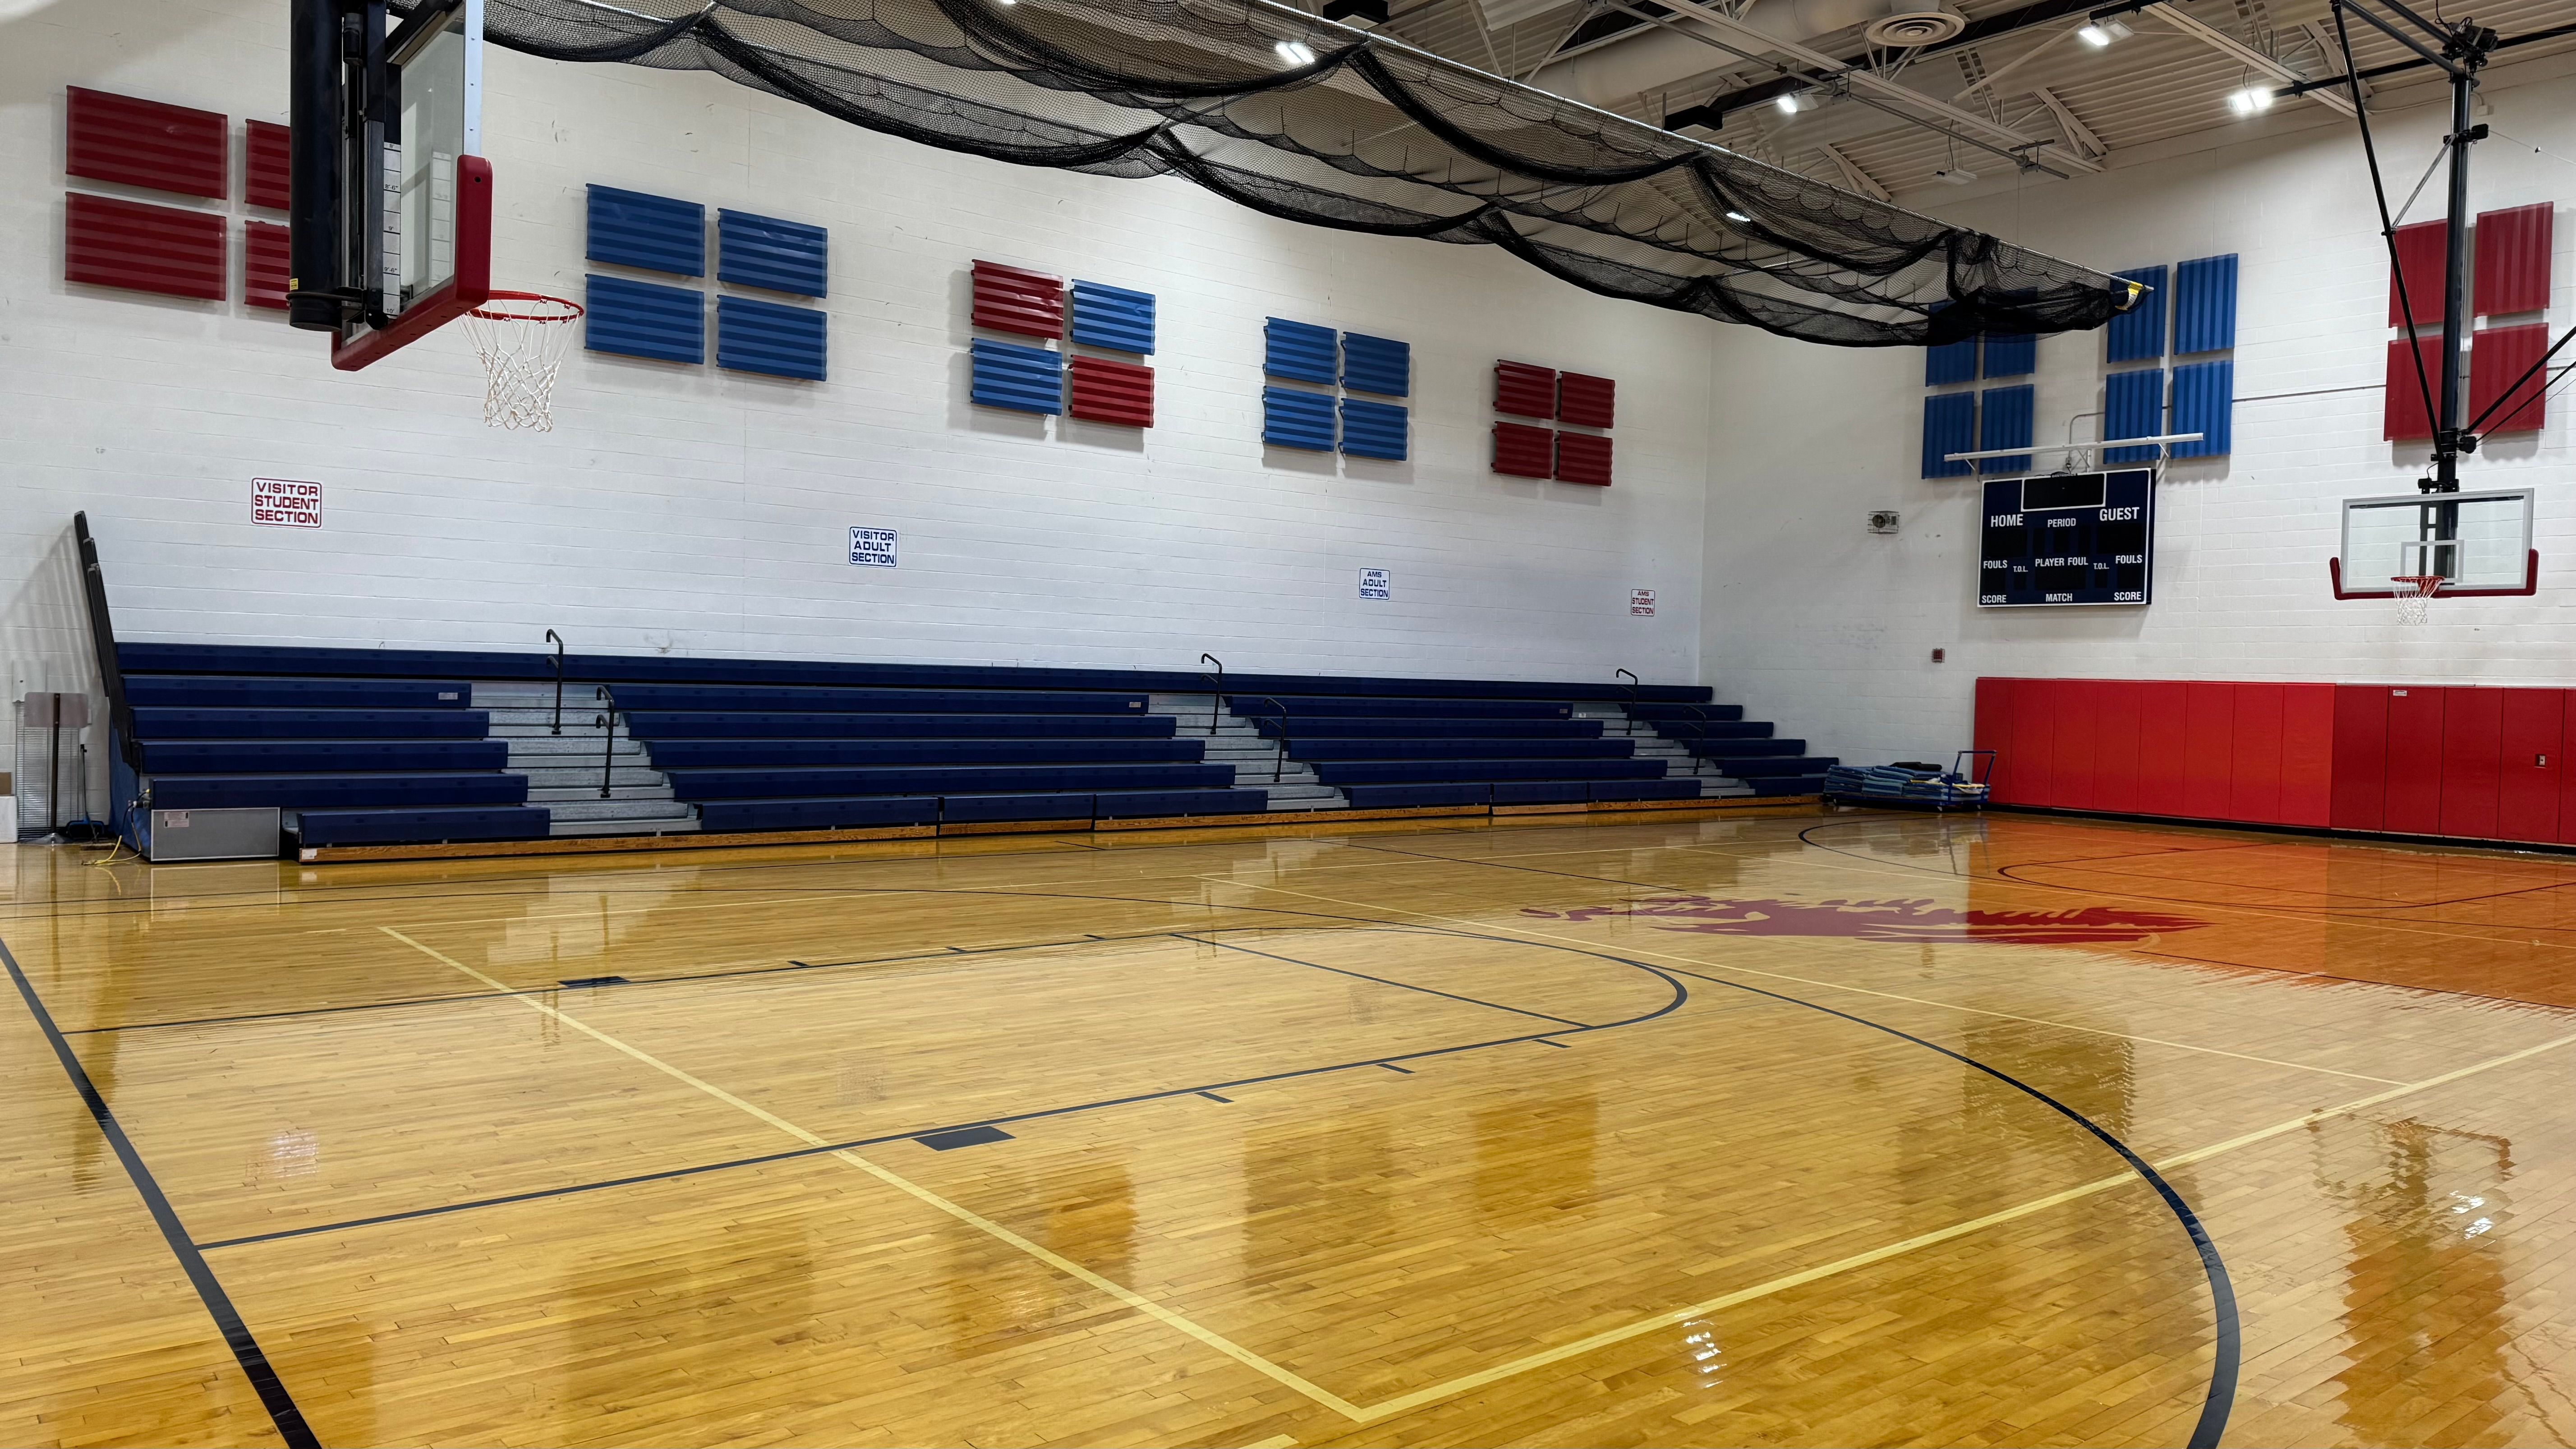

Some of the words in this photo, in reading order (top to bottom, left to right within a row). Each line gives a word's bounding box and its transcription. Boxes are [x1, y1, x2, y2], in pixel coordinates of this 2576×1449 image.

[256, 482, 318, 496] VISITOR
[255, 495, 319, 510] STUDENT
[255, 509, 318, 524] SECTION
[2099, 506, 2139, 521] GUEST
[1991, 514, 2024, 527] HOME
[2047, 518, 2076, 528] PERIOD
[852, 529, 894, 542] VISITOR
[854, 541, 891, 552] ADULT
[851, 552, 894, 564] SECTION
[2035, 558, 2065, 567] PLAYER
[2068, 557, 2088, 566] FOUL
[2115, 554, 2143, 564] FOULS
[1983, 560, 2008, 569] FOULS
[1362, 579, 1387, 587] ADULT
[1360, 588, 1388, 598] SECTION
[2046, 593, 2073, 603] MATCH
[2114, 591, 2142, 601] SCORE
[1632, 597, 1654, 606] STUDENT
[1982, 594, 2007, 603] SCORE
